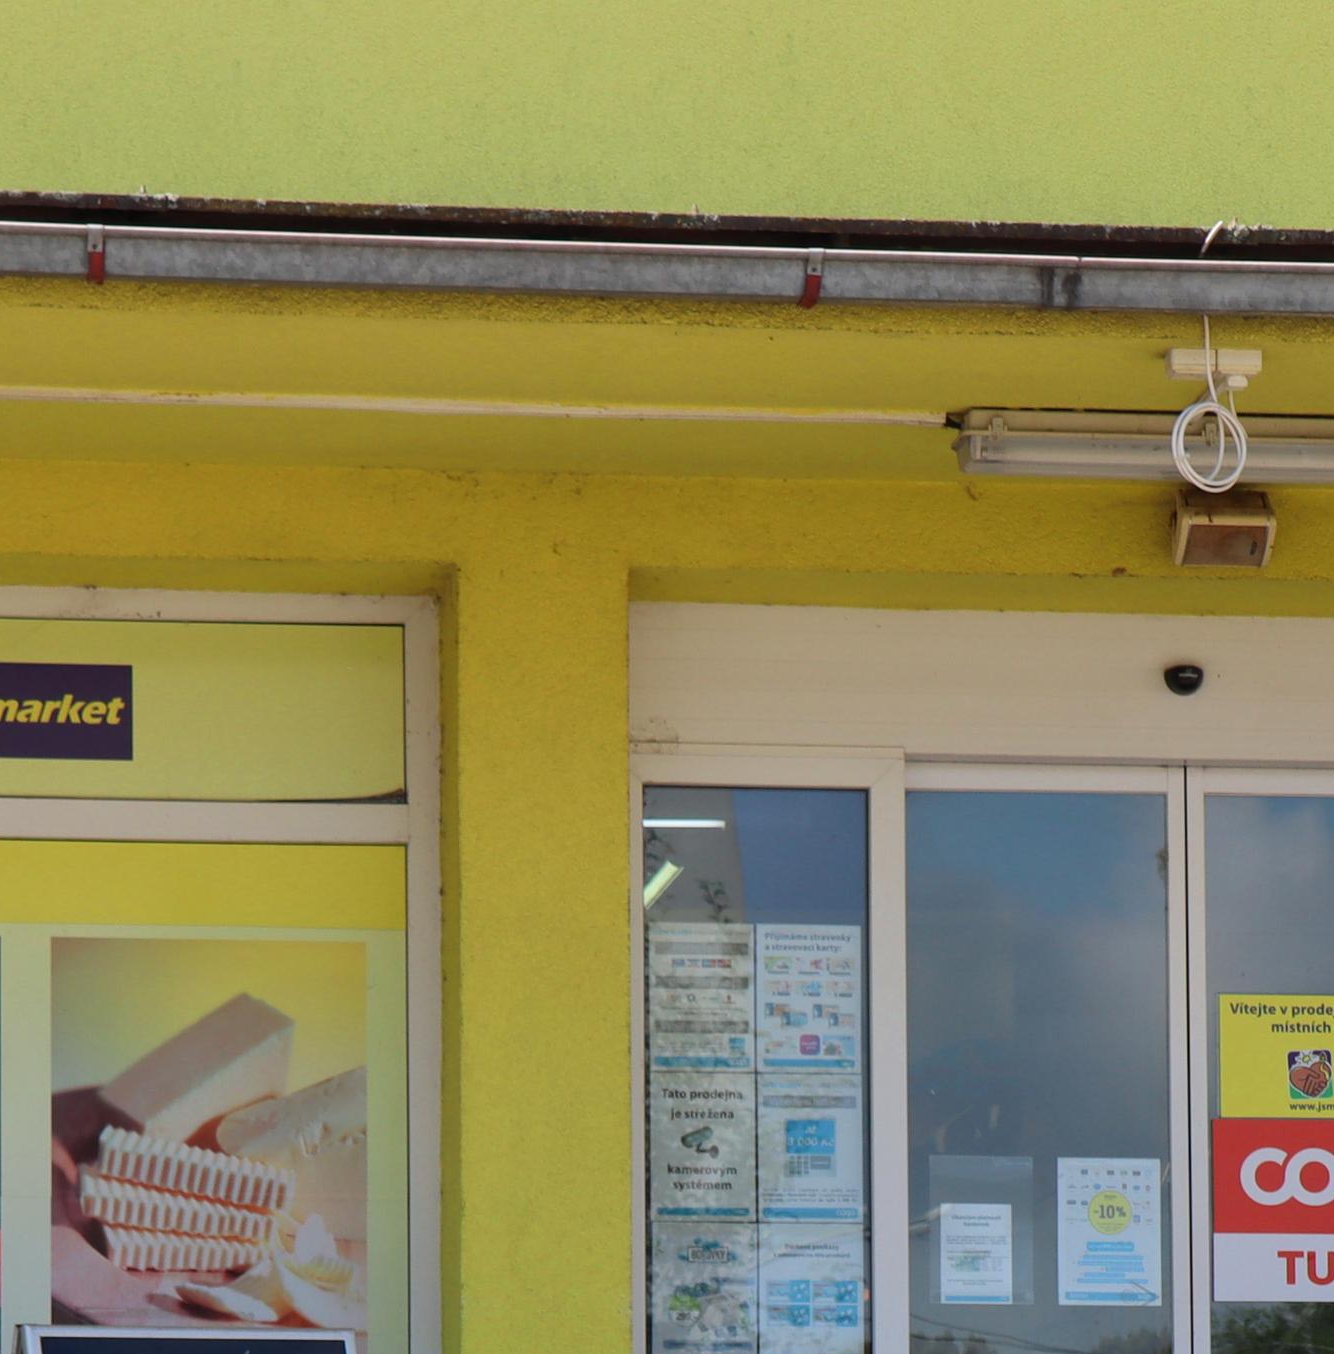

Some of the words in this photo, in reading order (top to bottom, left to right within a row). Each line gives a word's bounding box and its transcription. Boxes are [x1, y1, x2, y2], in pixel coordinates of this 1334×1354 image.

[1229, 1002, 1277, 1018] Vítejte
[1280, 1006, 1288, 1015] v
[1271, 1021, 1331, 1034] místních
[662, 1088, 687, 1099] Tato
[690, 1088, 743, 1102] prodejna
[671, 1109, 681, 1120] je
[668, 1163, 737, 1176] kamerovým
[673, 1180, 732, 1191] systémem
